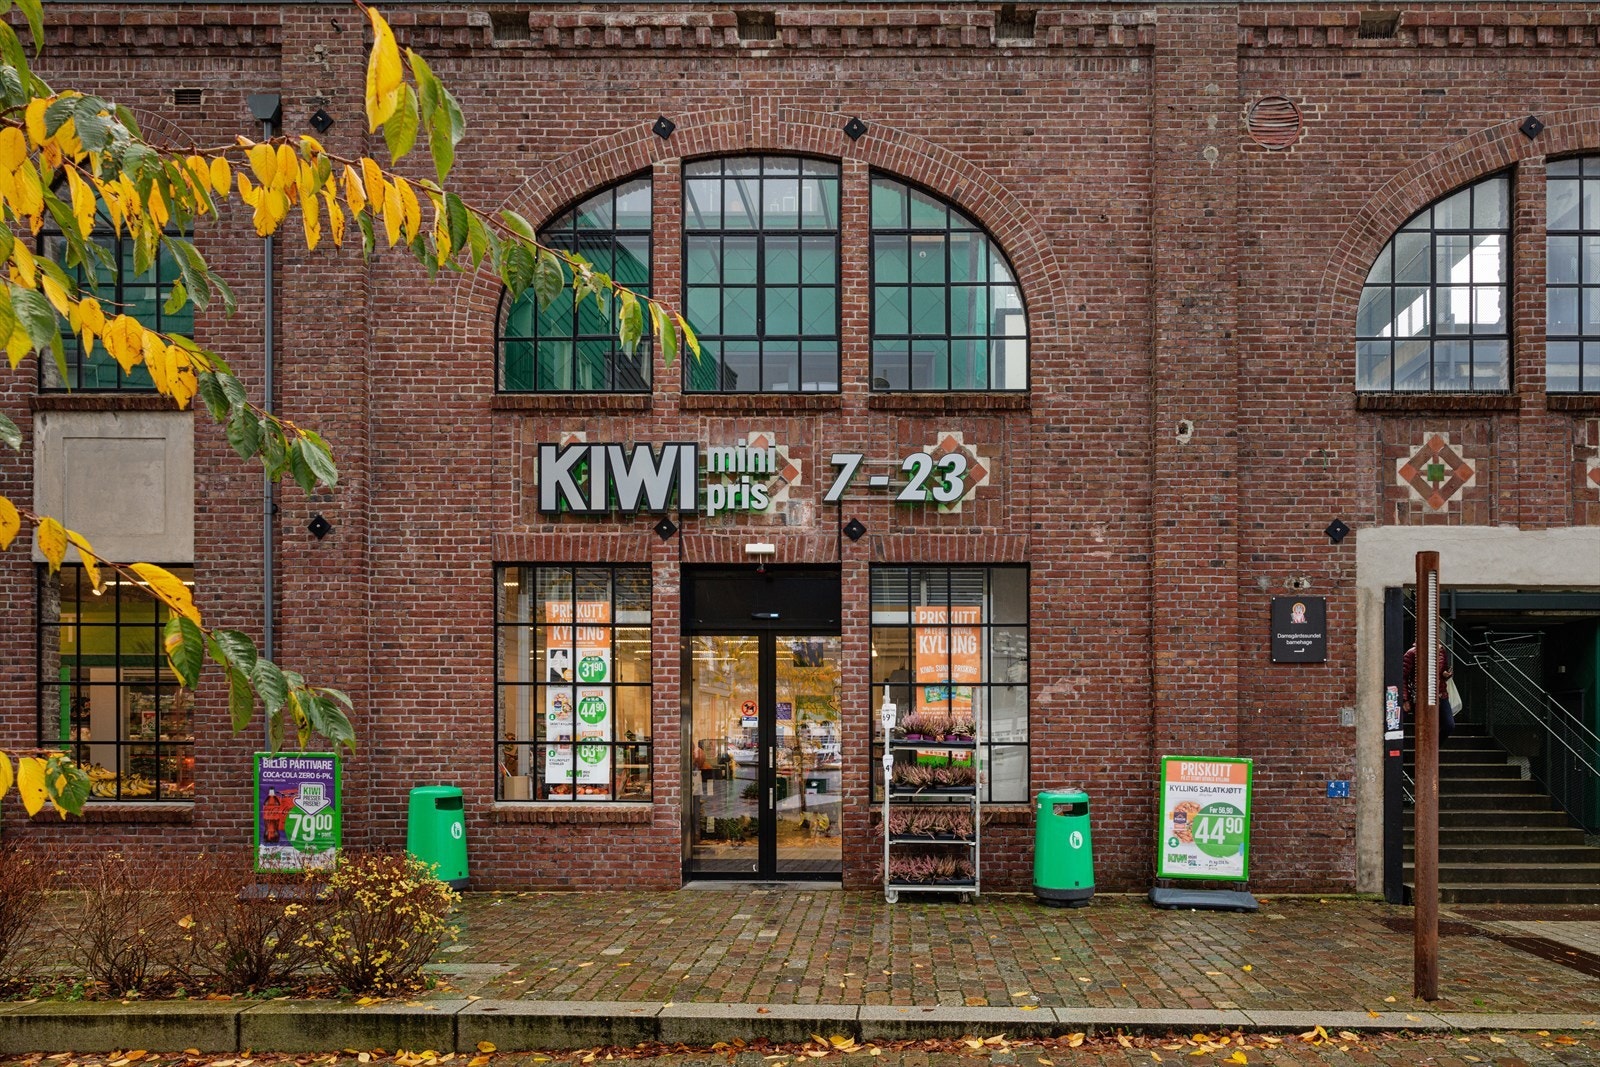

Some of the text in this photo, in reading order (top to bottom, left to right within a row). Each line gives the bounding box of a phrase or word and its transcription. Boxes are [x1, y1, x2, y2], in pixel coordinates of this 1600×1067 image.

[707, 439, 776, 472] mini
[539, 443, 698, 513] KIWI
[707, 476, 769, 516] pris
[290, 760, 333, 770] PARTIVARE
[1180, 762, 1232, 777] PRISKUTT
[262, 771, 298, 779] COCA-COLA
[303, 787, 321, 795] KIWI
[1169, 784, 1242, 795] KYLLING SALATKJØTT
